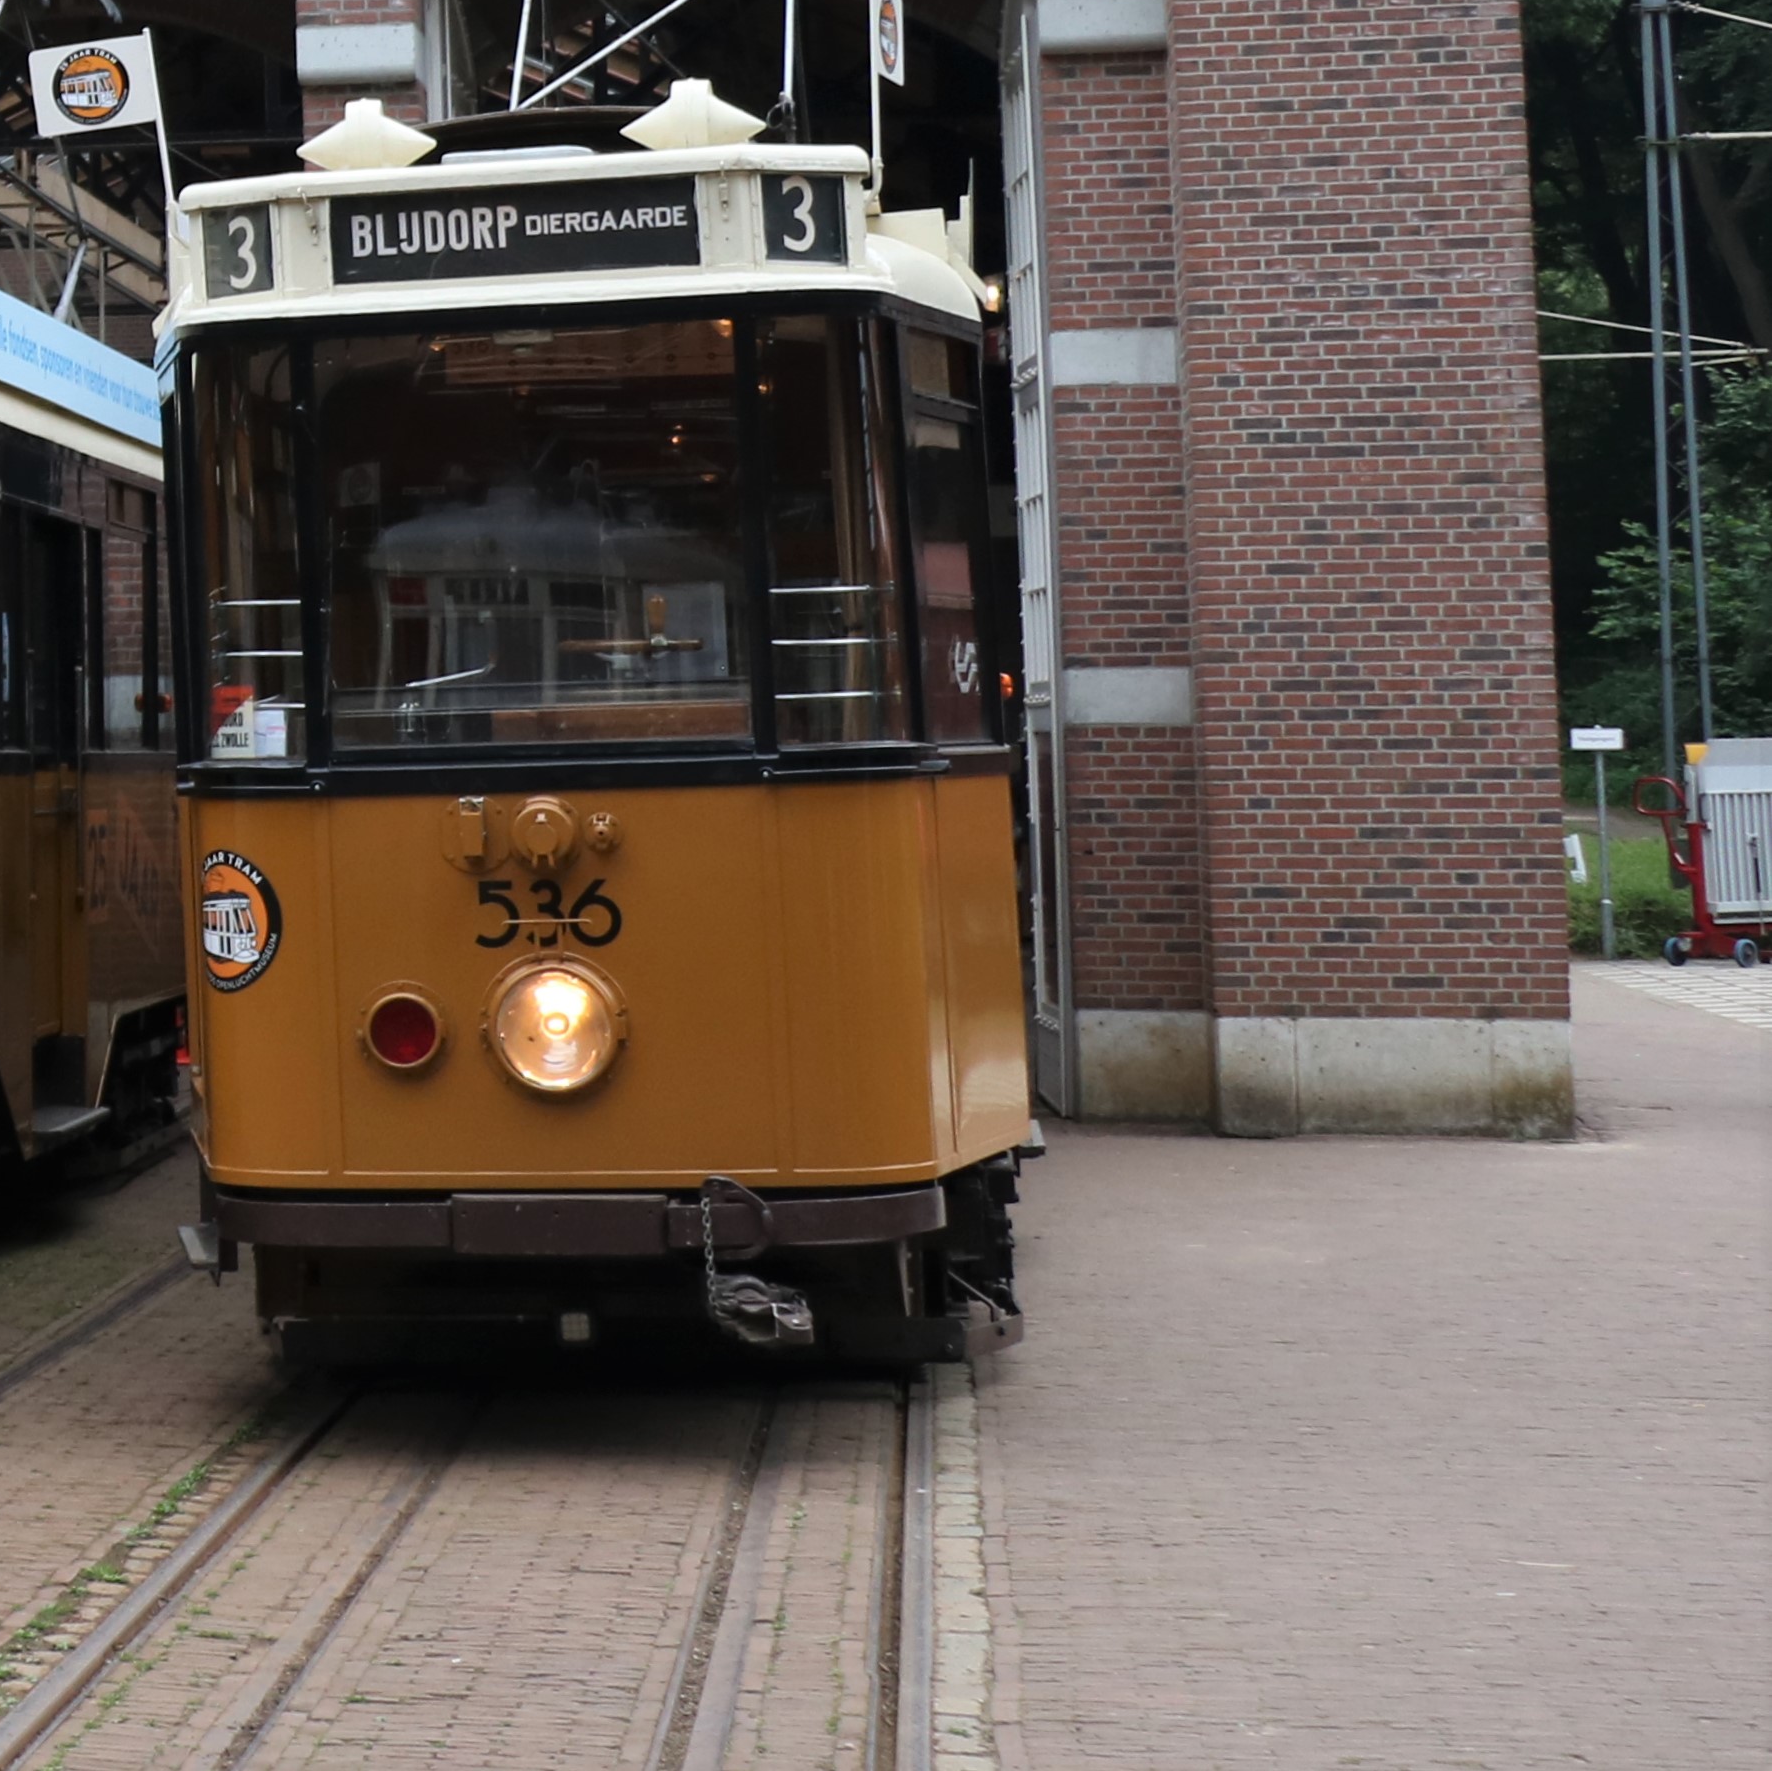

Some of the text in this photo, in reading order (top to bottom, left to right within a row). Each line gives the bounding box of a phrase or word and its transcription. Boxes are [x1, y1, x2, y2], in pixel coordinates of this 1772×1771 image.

[524, 204, 689, 237] DIERGAARDE
[779, 175, 818, 253] 3
[227, 214, 259, 290] 3
[221, 732, 249, 748] ZWOLLE
[228, 854, 263, 886] TRAM
[476, 878, 624, 949] 536
